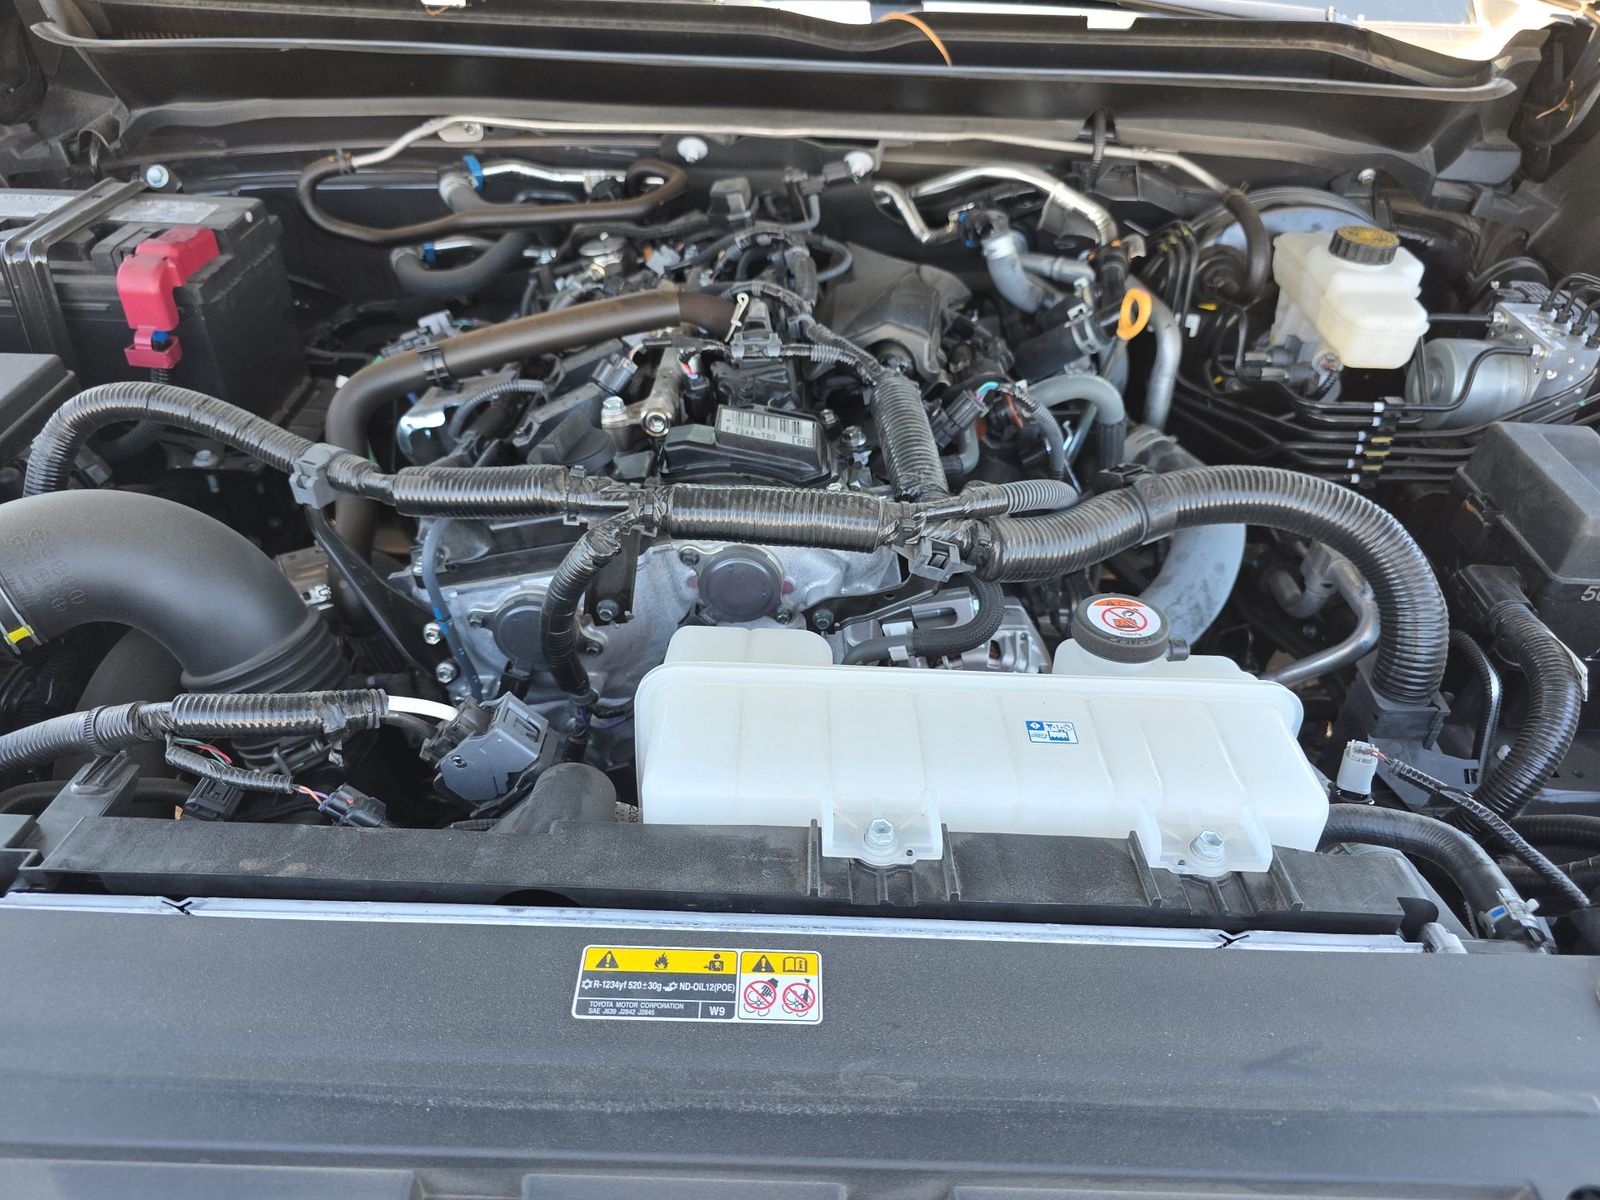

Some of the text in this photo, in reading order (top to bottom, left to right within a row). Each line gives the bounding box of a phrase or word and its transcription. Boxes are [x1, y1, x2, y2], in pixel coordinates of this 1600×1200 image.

[593, 981, 736, 993] R-1234yf 520±30g ND-OIL12(POE)
[640, 1002, 685, 1010] CORPORATION
[709, 1006, 726, 1016] W9
